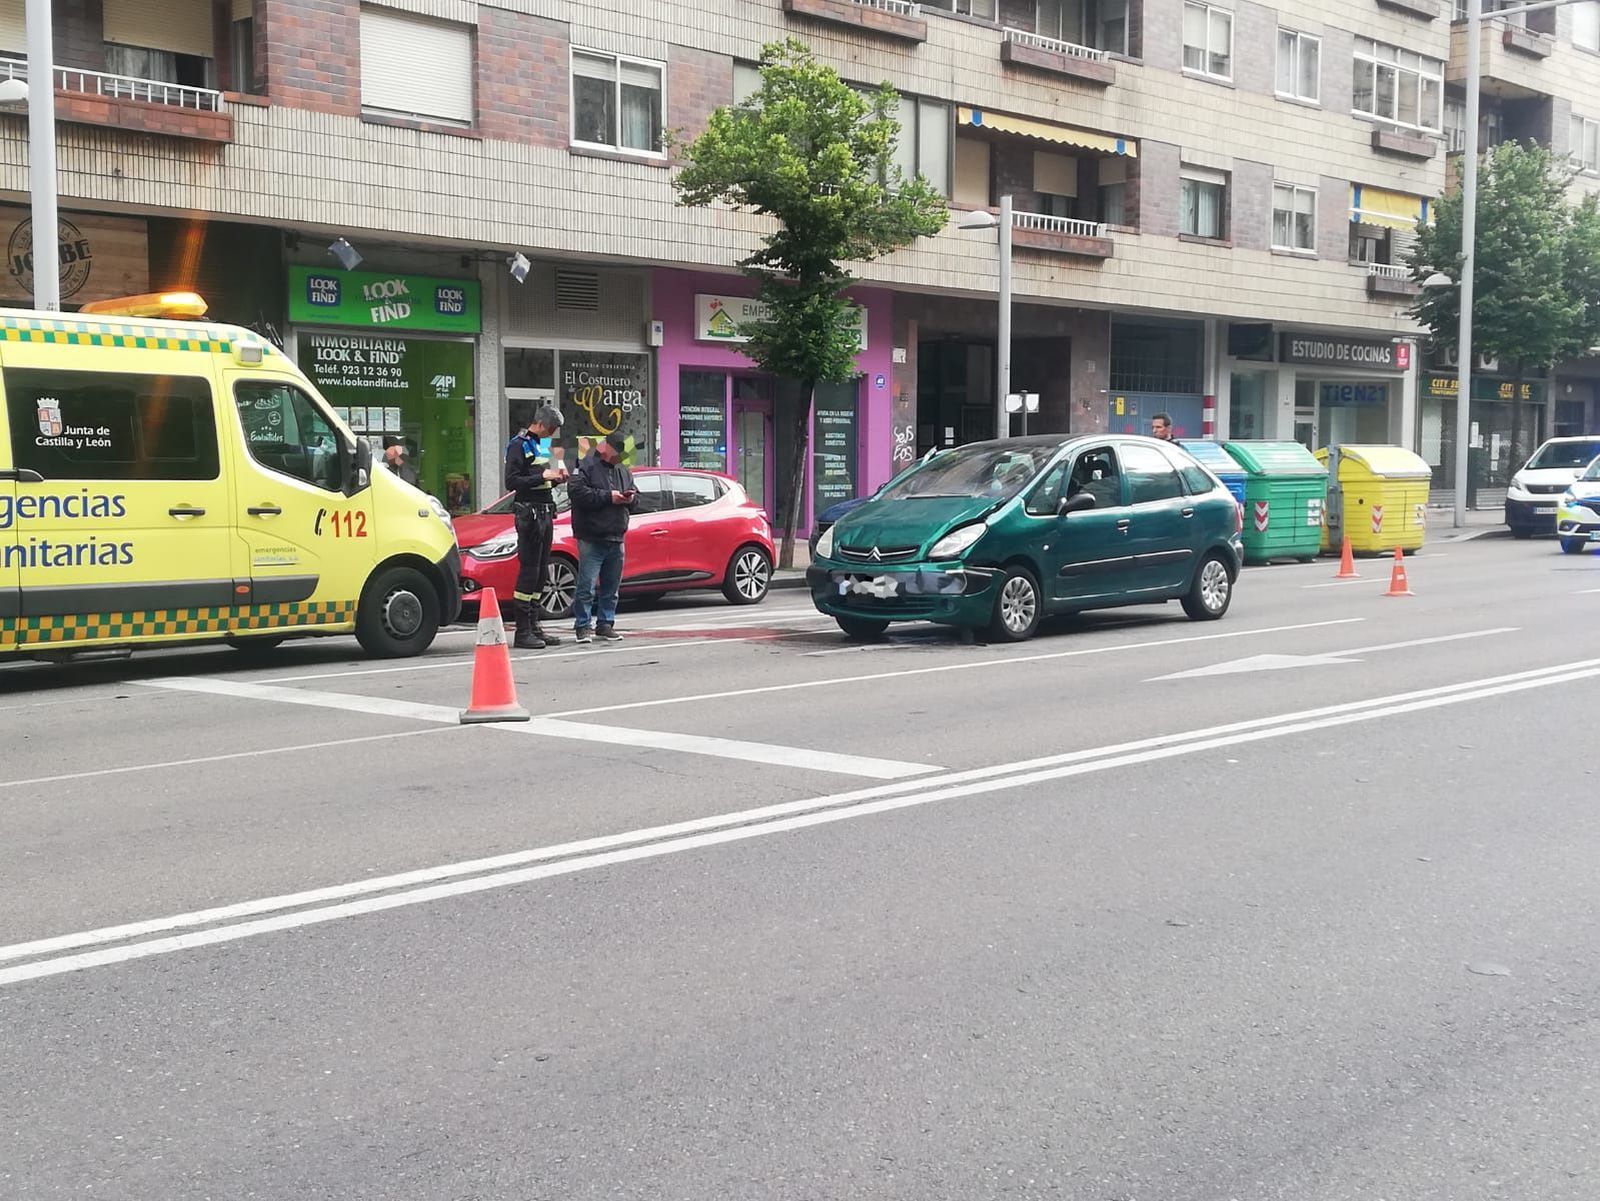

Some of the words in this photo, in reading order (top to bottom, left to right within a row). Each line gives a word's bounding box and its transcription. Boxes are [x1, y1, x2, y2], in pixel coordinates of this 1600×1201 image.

[10, 239, 92, 276] JOBE
[310, 278, 337, 290] LOOK
[363, 279, 410, 301] LOOK
[312, 291, 336, 303] FIND
[438, 288, 463, 300] LOOK
[370, 303, 411, 323] FIND
[440, 301, 462, 313] FIND
[742, 303, 776, 318] EMPR
[311, 335, 406, 352] INMOBILIARIA
[317, 347, 351, 361] LOOK
[354, 350, 365, 362] &
[370, 350, 399, 364] FIND
[1292, 340, 1335, 359] ESTUDIO
[1336, 343, 1350, 360] DE
[1351, 345, 1391, 363] COCINAS
[314, 363, 339, 374] Teléf.
[342, 365, 360, 375] 923
[363, 366, 374, 375] 12
[376, 367, 388, 376] 36
[391, 367, 402, 377] 90
[317, 376, 408, 388] www.lookandfind.es
[436, 375, 456, 388] API
[565, 370, 576, 385] El
[579, 371, 631, 387] Costurero
[1431, 378, 1448, 387] CITY
[1450, 379, 1459, 388] SE
[64, 425, 94, 436] Junta
[96, 425, 111, 436] de
[35, 436, 74, 447] Castilla
[76, 438, 83, 450] y
[86, 436, 112, 447] León
[331, 510, 367, 538] 112
[0, 536, 134, 568] nitarias
